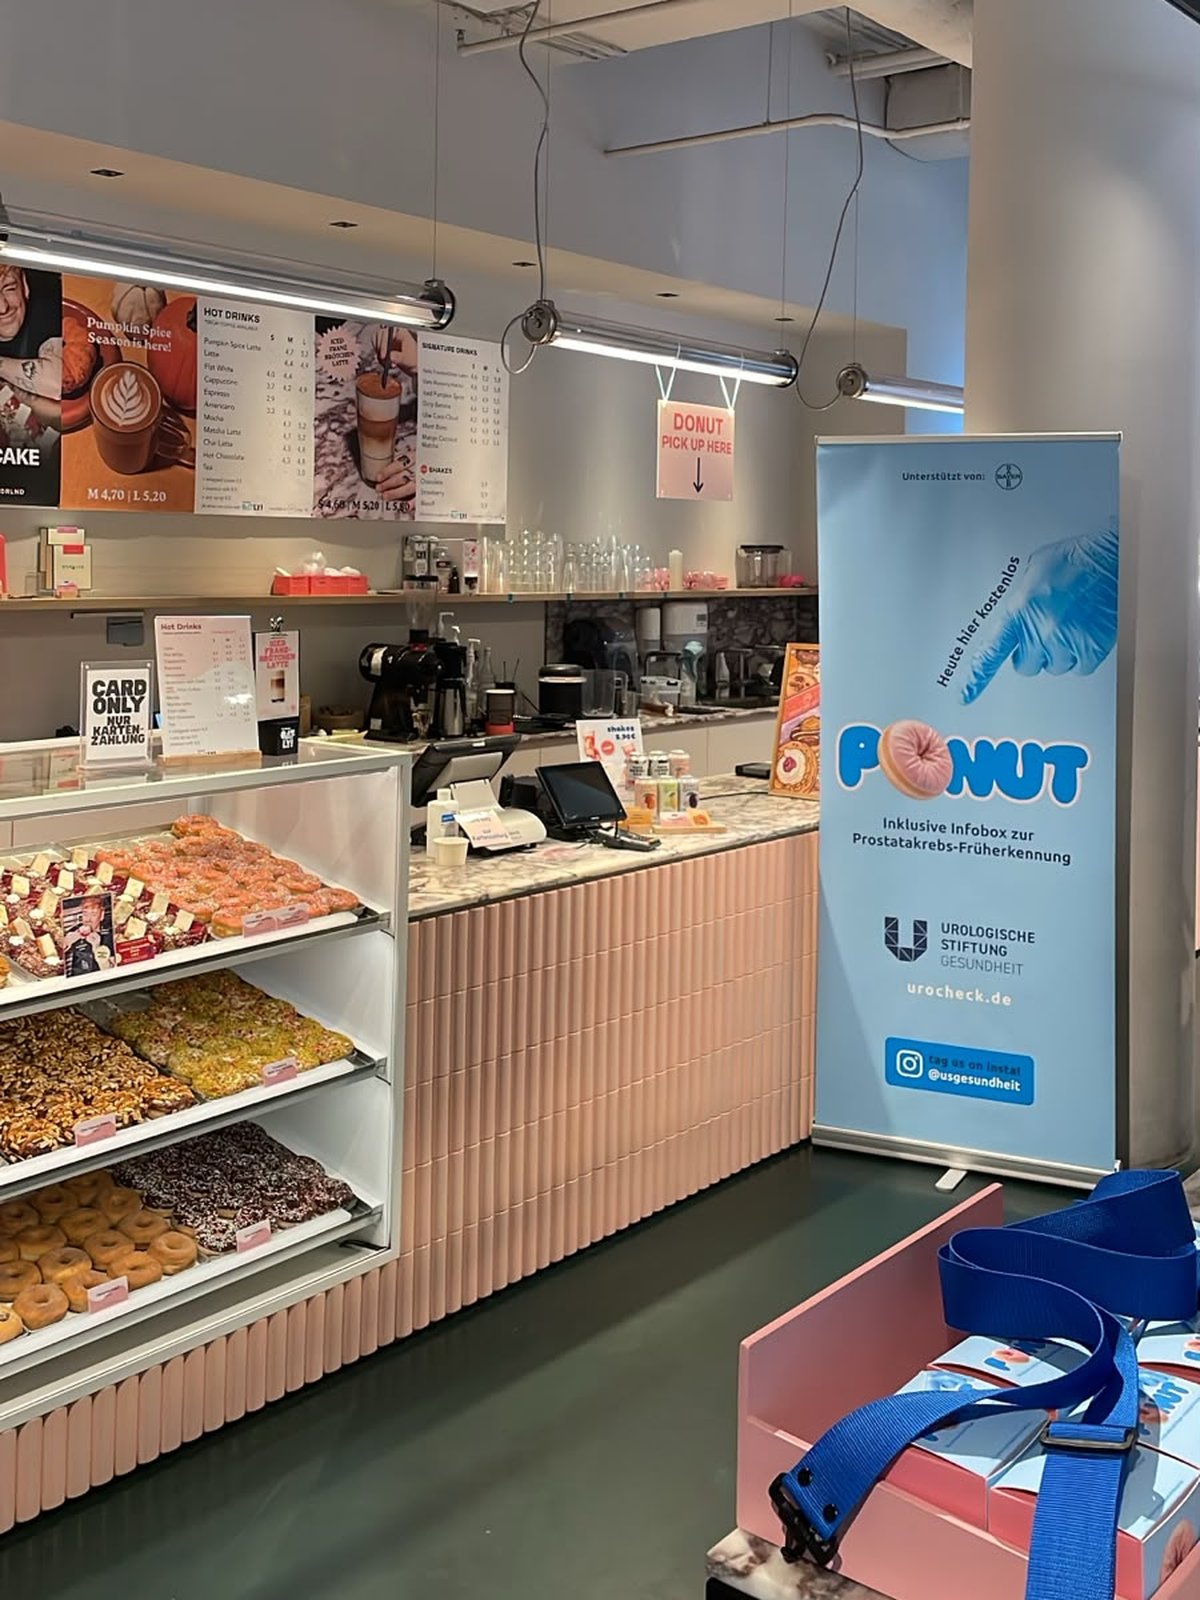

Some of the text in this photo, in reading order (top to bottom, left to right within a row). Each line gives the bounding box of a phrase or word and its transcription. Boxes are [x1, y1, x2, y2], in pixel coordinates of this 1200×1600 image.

[204, 308, 260, 323] HOT DRINKS
[86, 316, 172, 339] Pumpkin Spice
[87, 331, 172, 353] Season is here!
[674, 412, 723, 435] DONUT
[662, 435, 732, 454] PICK UP HERE
[902, 472, 985, 481] Unterstützt von:
[87, 488, 98, 499] M
[133, 490, 140, 501] L
[161, 623, 175, 631] Hot
[937, 555, 1020, 687] Heute hier kostenlos
[92, 679, 147, 697] CARD
[93, 696, 145, 715] ONLY
[93, 725, 144, 736] KARTEN-
[107, 716, 131, 726] NUR
[91, 734, 145, 746] ZAHLUNG
[882, 817, 1035, 841] Inklusive Infobox zur
[852, 832, 1072, 866] Prostatakrebs-Früherkennung
[941, 922, 1035, 944] UROLOGISCHE
[941, 939, 1007, 957] STIFTUNG
[940, 955, 1024, 976] GESUNDHEIT
[907, 982, 1012, 1006] urocheck.de
[929, 1055, 948, 1067] tag
[952, 1058, 964, 1067] us
[968, 1061, 983, 1071] on
[928, 1068, 1021, 1092] @usgesundheit
